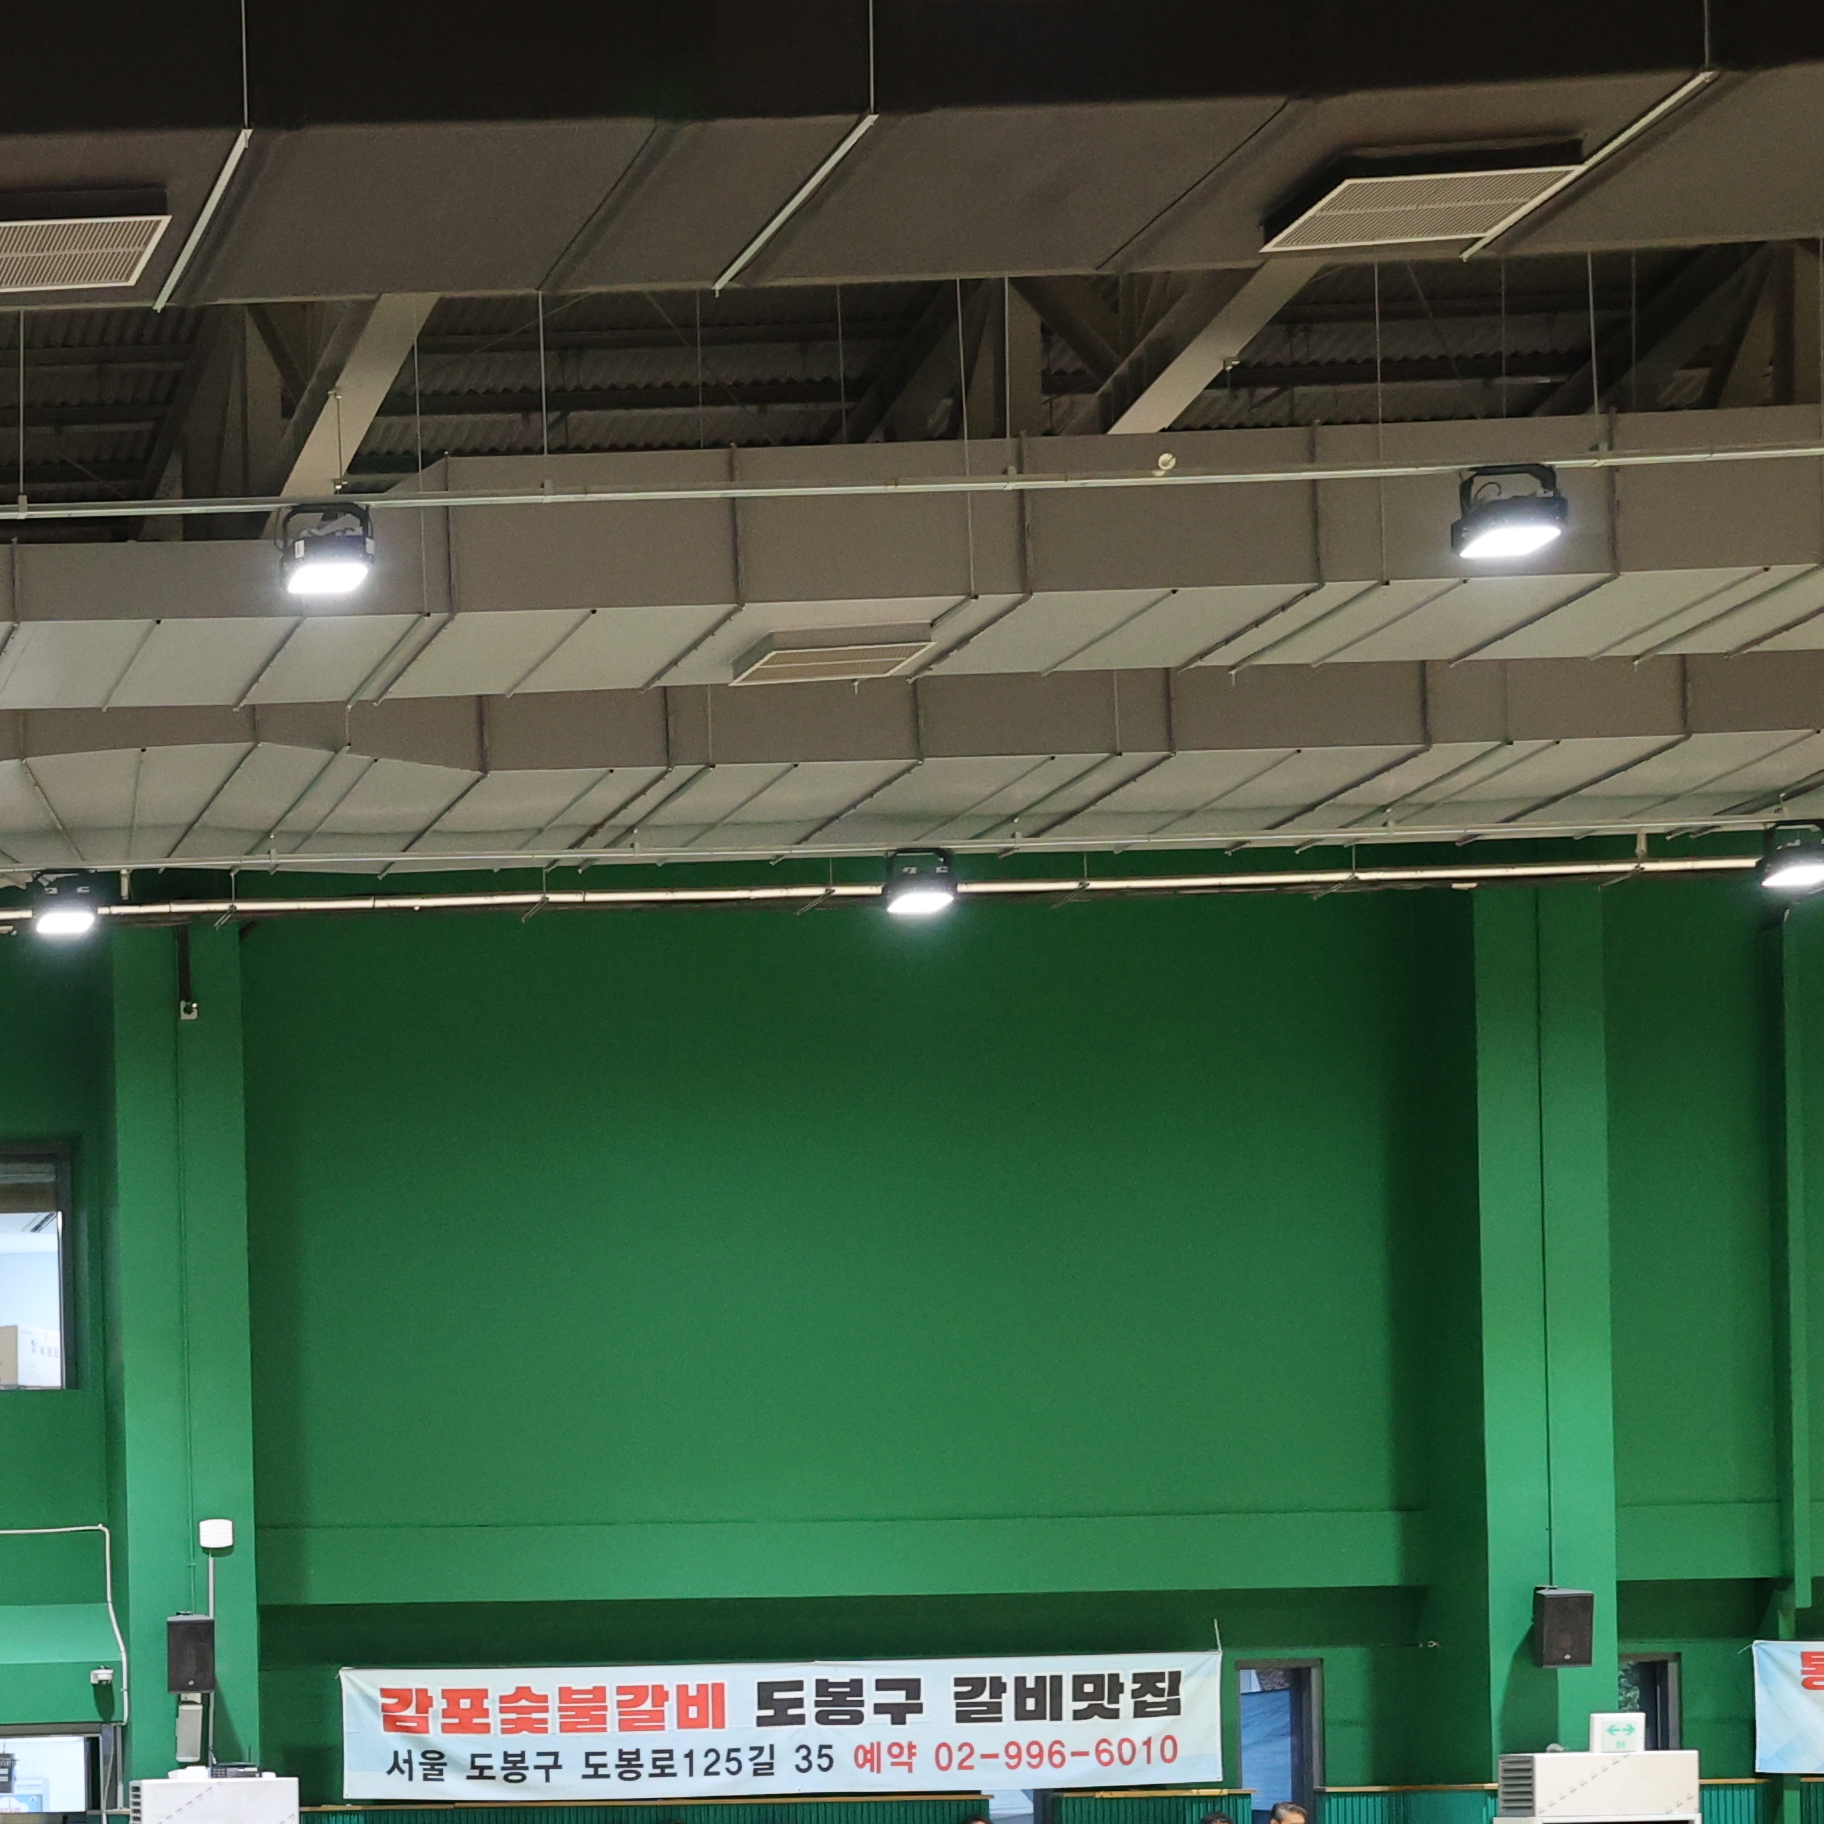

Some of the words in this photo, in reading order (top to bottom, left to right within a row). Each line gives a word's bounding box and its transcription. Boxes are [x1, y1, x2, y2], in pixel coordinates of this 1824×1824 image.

[379, 1682, 727, 1734] 감포숯불갈비
[755, 1677, 927, 1728] 도봉구
[953, 1671, 1183, 1724] 갈비맛집
[386, 1750, 448, 1784] 서울
[466, 1748, 565, 1784] 도봉구
[581, 1745, 777, 1783] 도봉로125길
[794, 1745, 835, 1774] 35
[853, 1743, 918, 1775] 예약
[934, 1735, 1180, 1771] 02-996-6010
